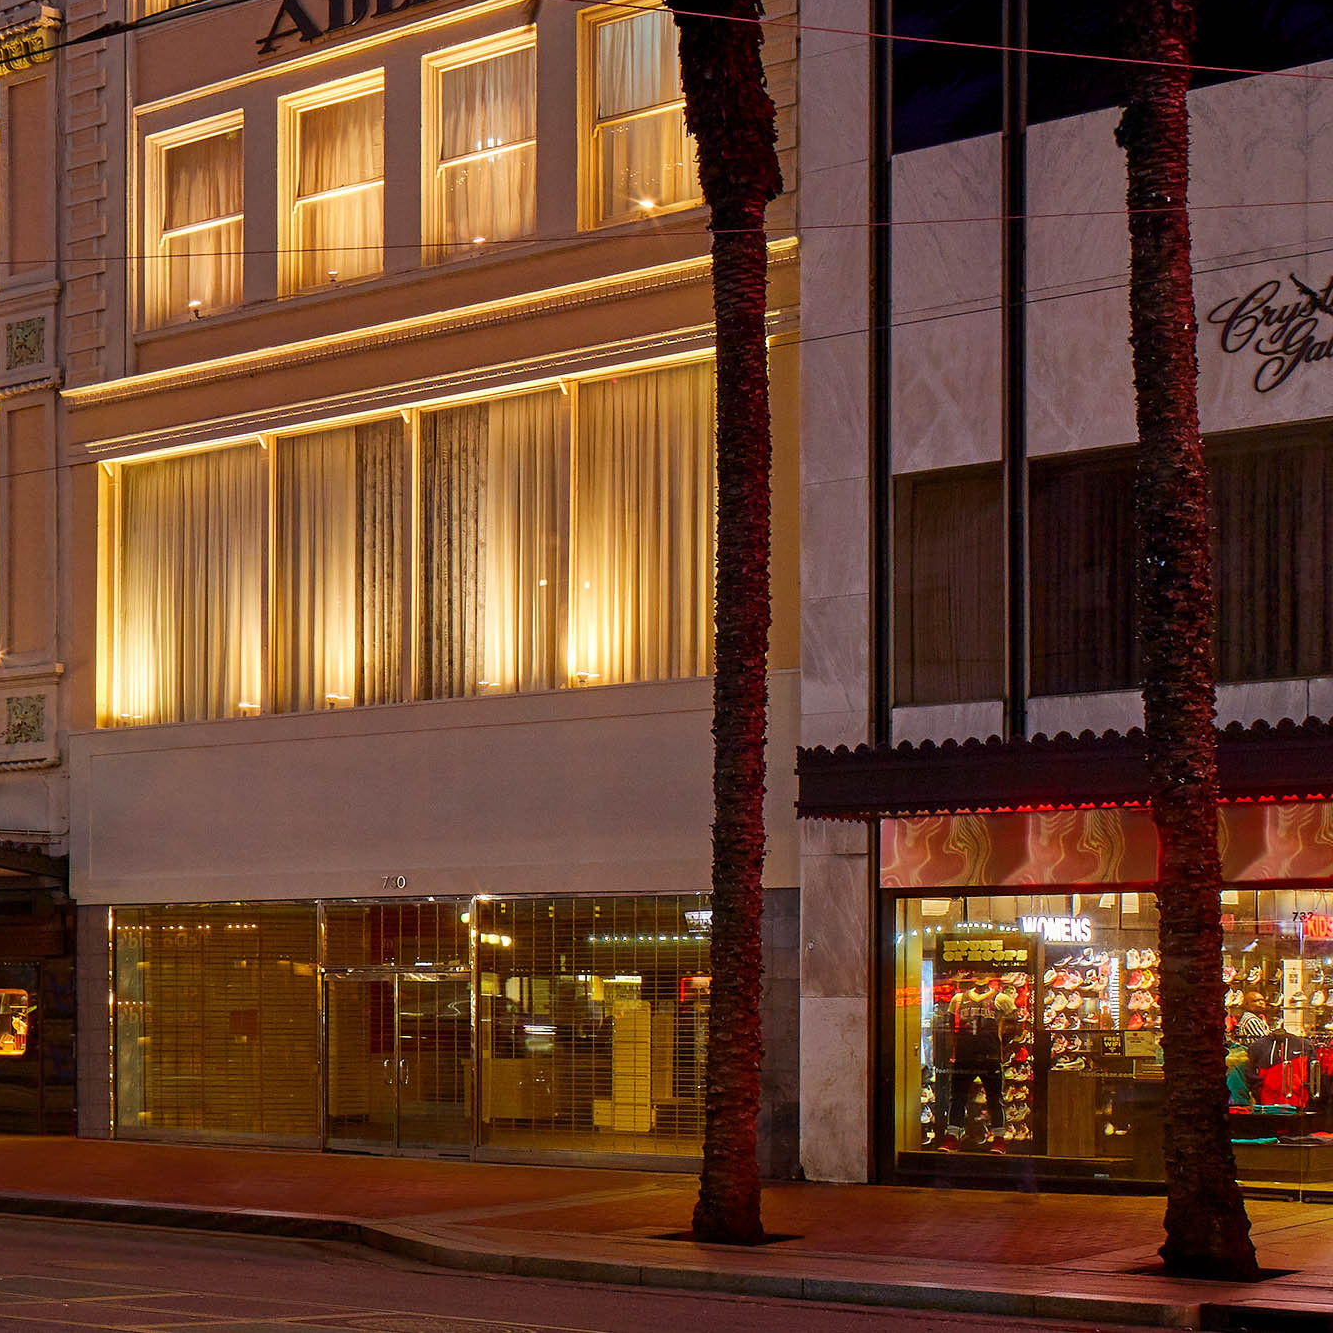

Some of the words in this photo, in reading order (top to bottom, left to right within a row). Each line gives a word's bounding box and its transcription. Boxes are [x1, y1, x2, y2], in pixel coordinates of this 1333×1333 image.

[1020, 916, 1092, 942] WOMENS
[943, 939, 1004, 951] HOUSE
[967, 949, 1028, 962] HOOPS
